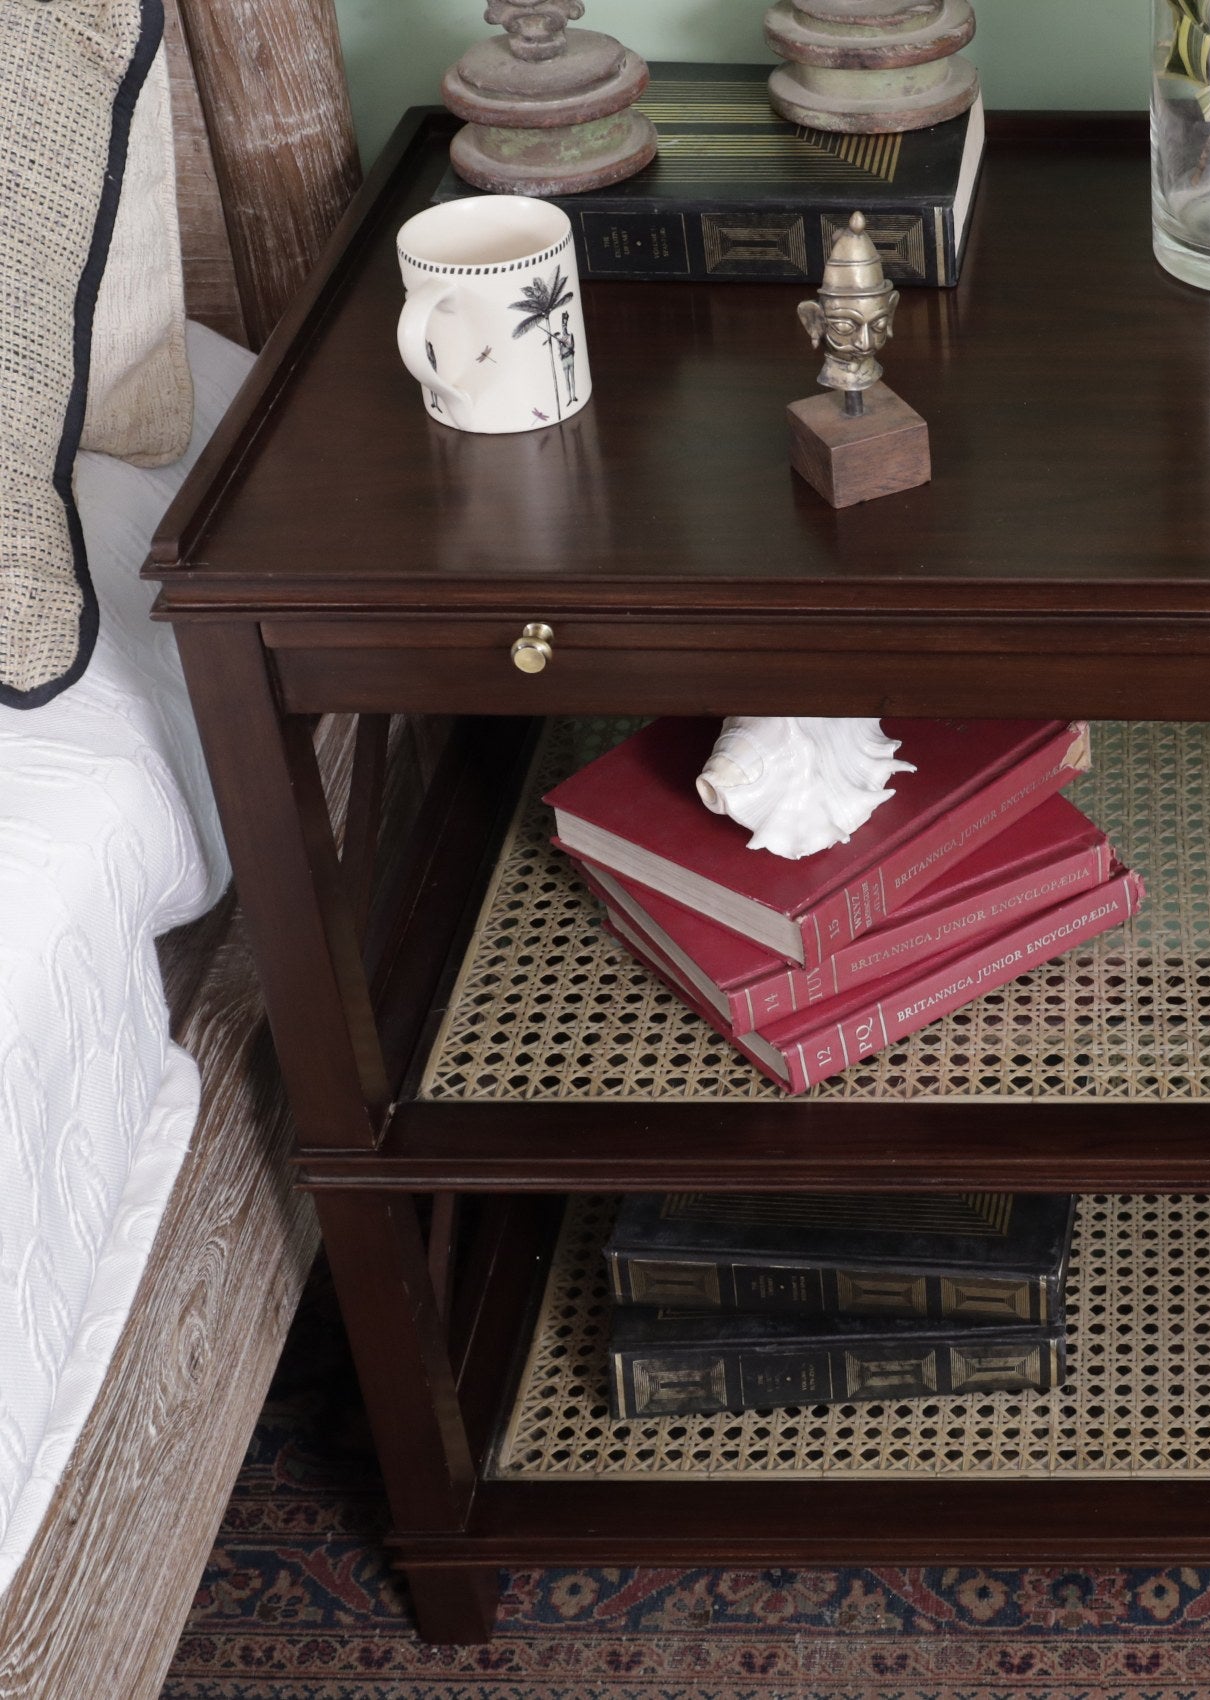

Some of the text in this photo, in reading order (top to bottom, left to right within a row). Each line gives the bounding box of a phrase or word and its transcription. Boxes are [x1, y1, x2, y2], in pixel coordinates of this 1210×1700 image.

[894, 839, 957, 889] BRITANNICA
[959, 809, 998, 847] JUNIOR
[828, 919, 840, 940] 15
[850, 933, 932, 973] BRITANNICA
[935, 911, 987, 942] JUNIOR
[764, 992, 780, 1013] 14
[896, 976, 974, 1023] BRITANNICA
[976, 951, 1023, 984] JUNIOR
[855, 1017, 874, 1054] PQ
[816, 1046, 833, 1067] 12
